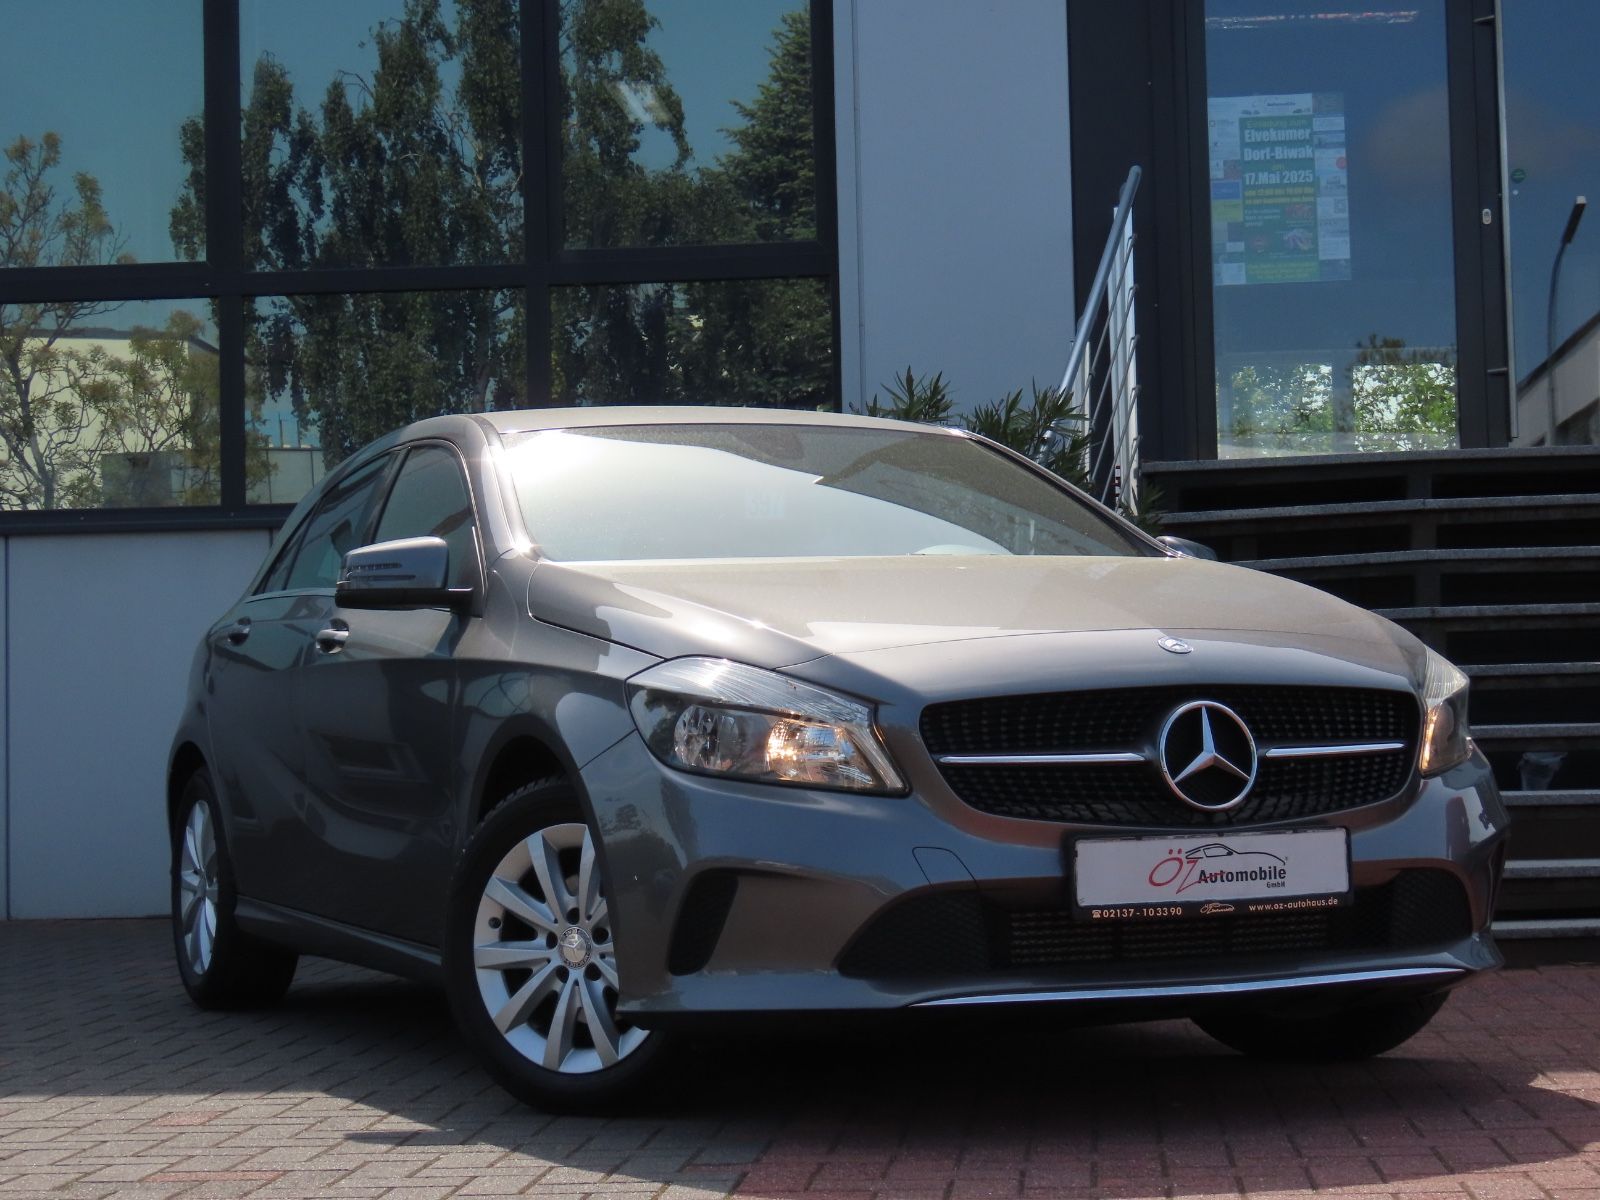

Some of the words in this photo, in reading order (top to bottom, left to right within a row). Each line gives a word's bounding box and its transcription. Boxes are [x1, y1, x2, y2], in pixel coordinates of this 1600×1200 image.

[1244, 128, 1311, 143] Elvekumer
[1243, 145, 1313, 161] Dorf-Biwak
[1282, 169, 1313, 184] 2025
[1199, 865, 1287, 884] Automobile
[1266, 881, 1286, 889] GmbH
[1248, 897, 1339, 912] www.oz-autohaus.de
